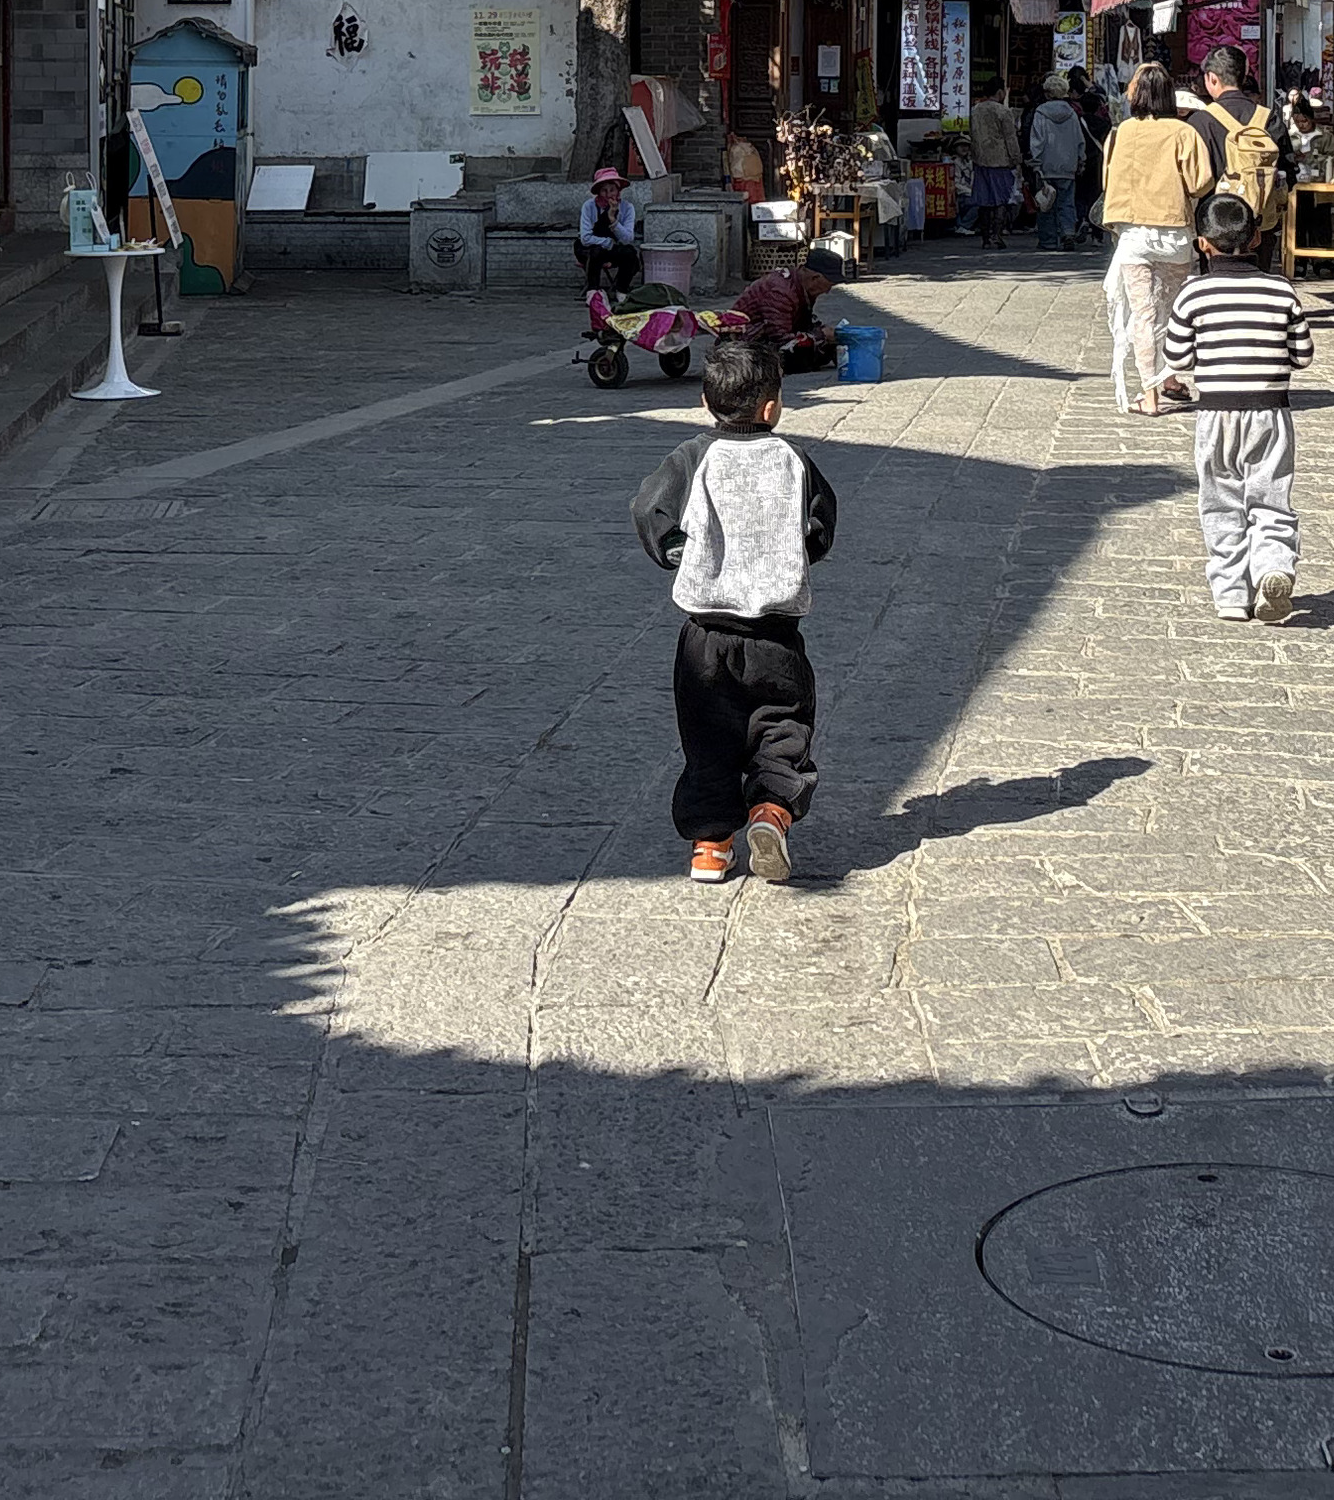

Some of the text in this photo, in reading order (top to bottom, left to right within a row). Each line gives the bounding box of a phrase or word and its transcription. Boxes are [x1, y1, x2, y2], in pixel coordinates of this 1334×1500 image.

[333, 13, 366, 57] 福
[952, 17, 967, 129] 秘制高原牦牛肉
